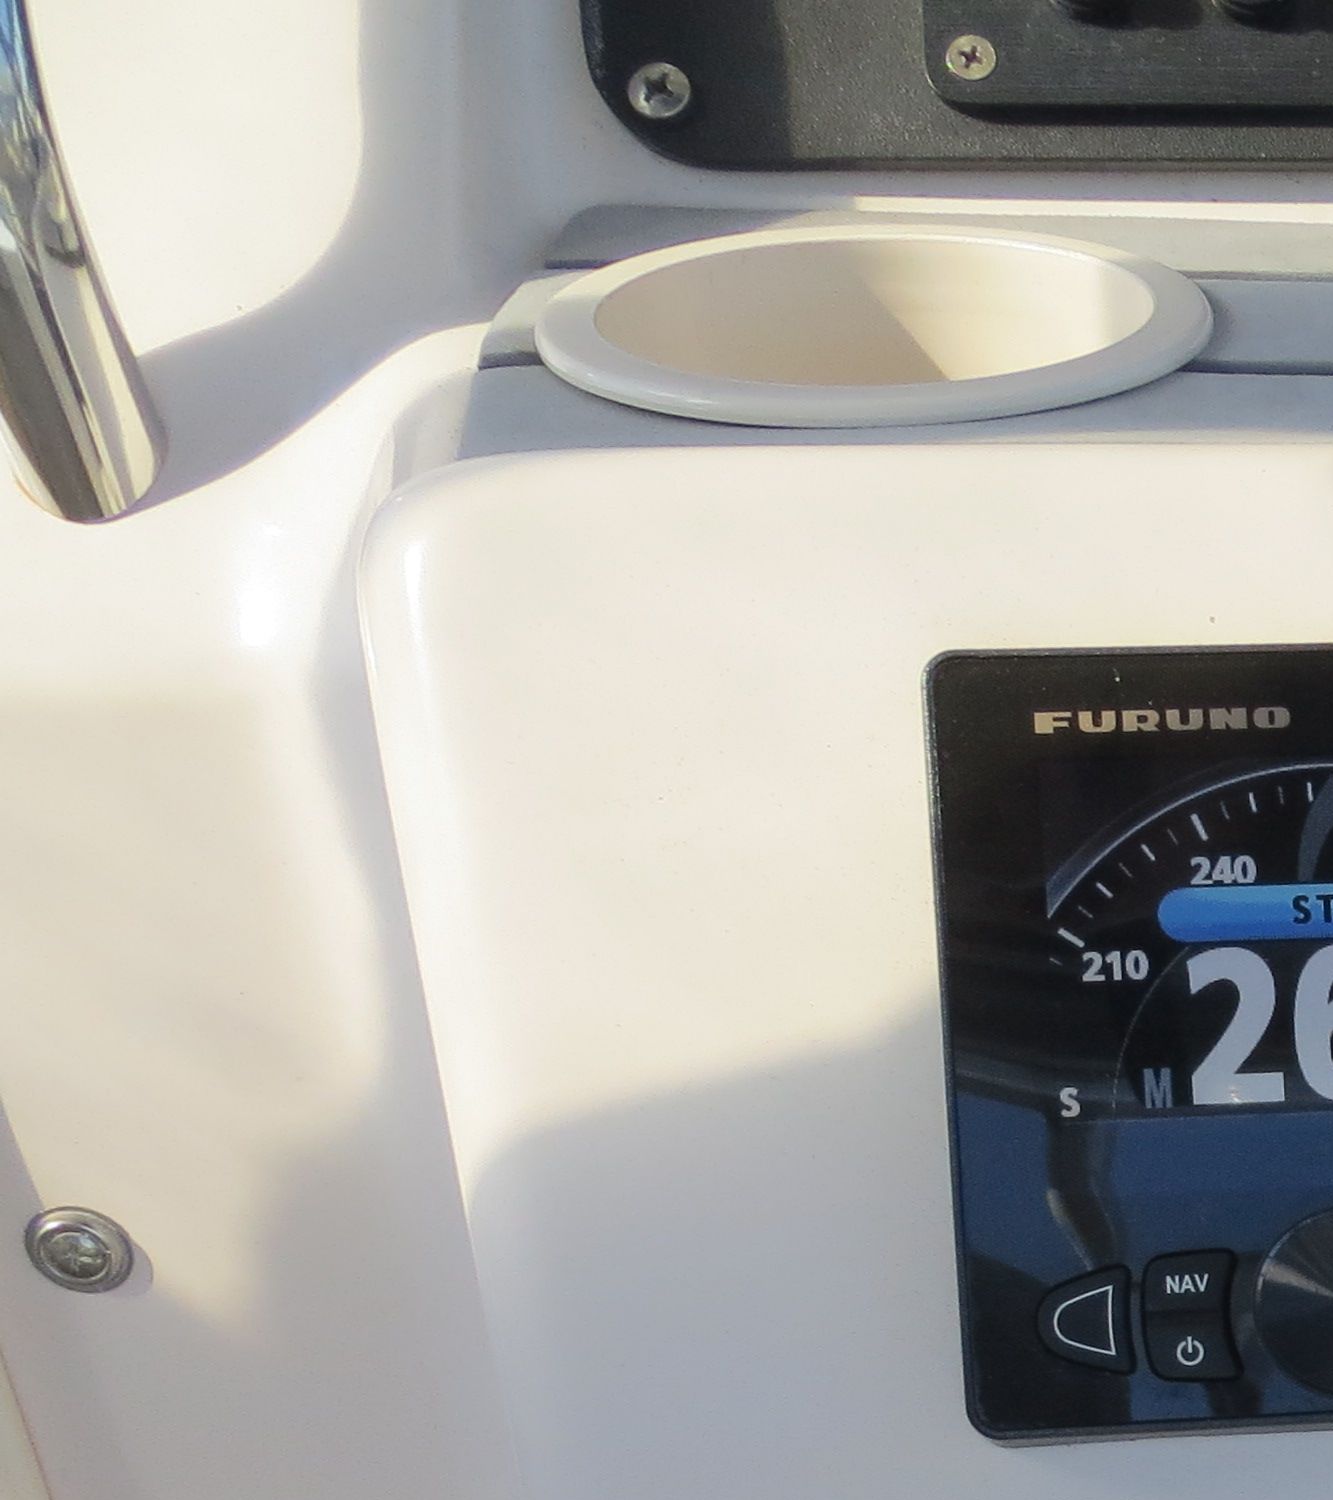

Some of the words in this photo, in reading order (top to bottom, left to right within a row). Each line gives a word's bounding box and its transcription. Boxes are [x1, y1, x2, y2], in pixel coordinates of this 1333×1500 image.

[1033, 706, 1292, 735] FURUNO
[1189, 855, 1258, 887] 240
[1080, 948, 1150, 985] 210
[1058, 1086, 1083, 1121] S
[1142, 1068, 1175, 1111] M
[1165, 1273, 1210, 1298] NAV
